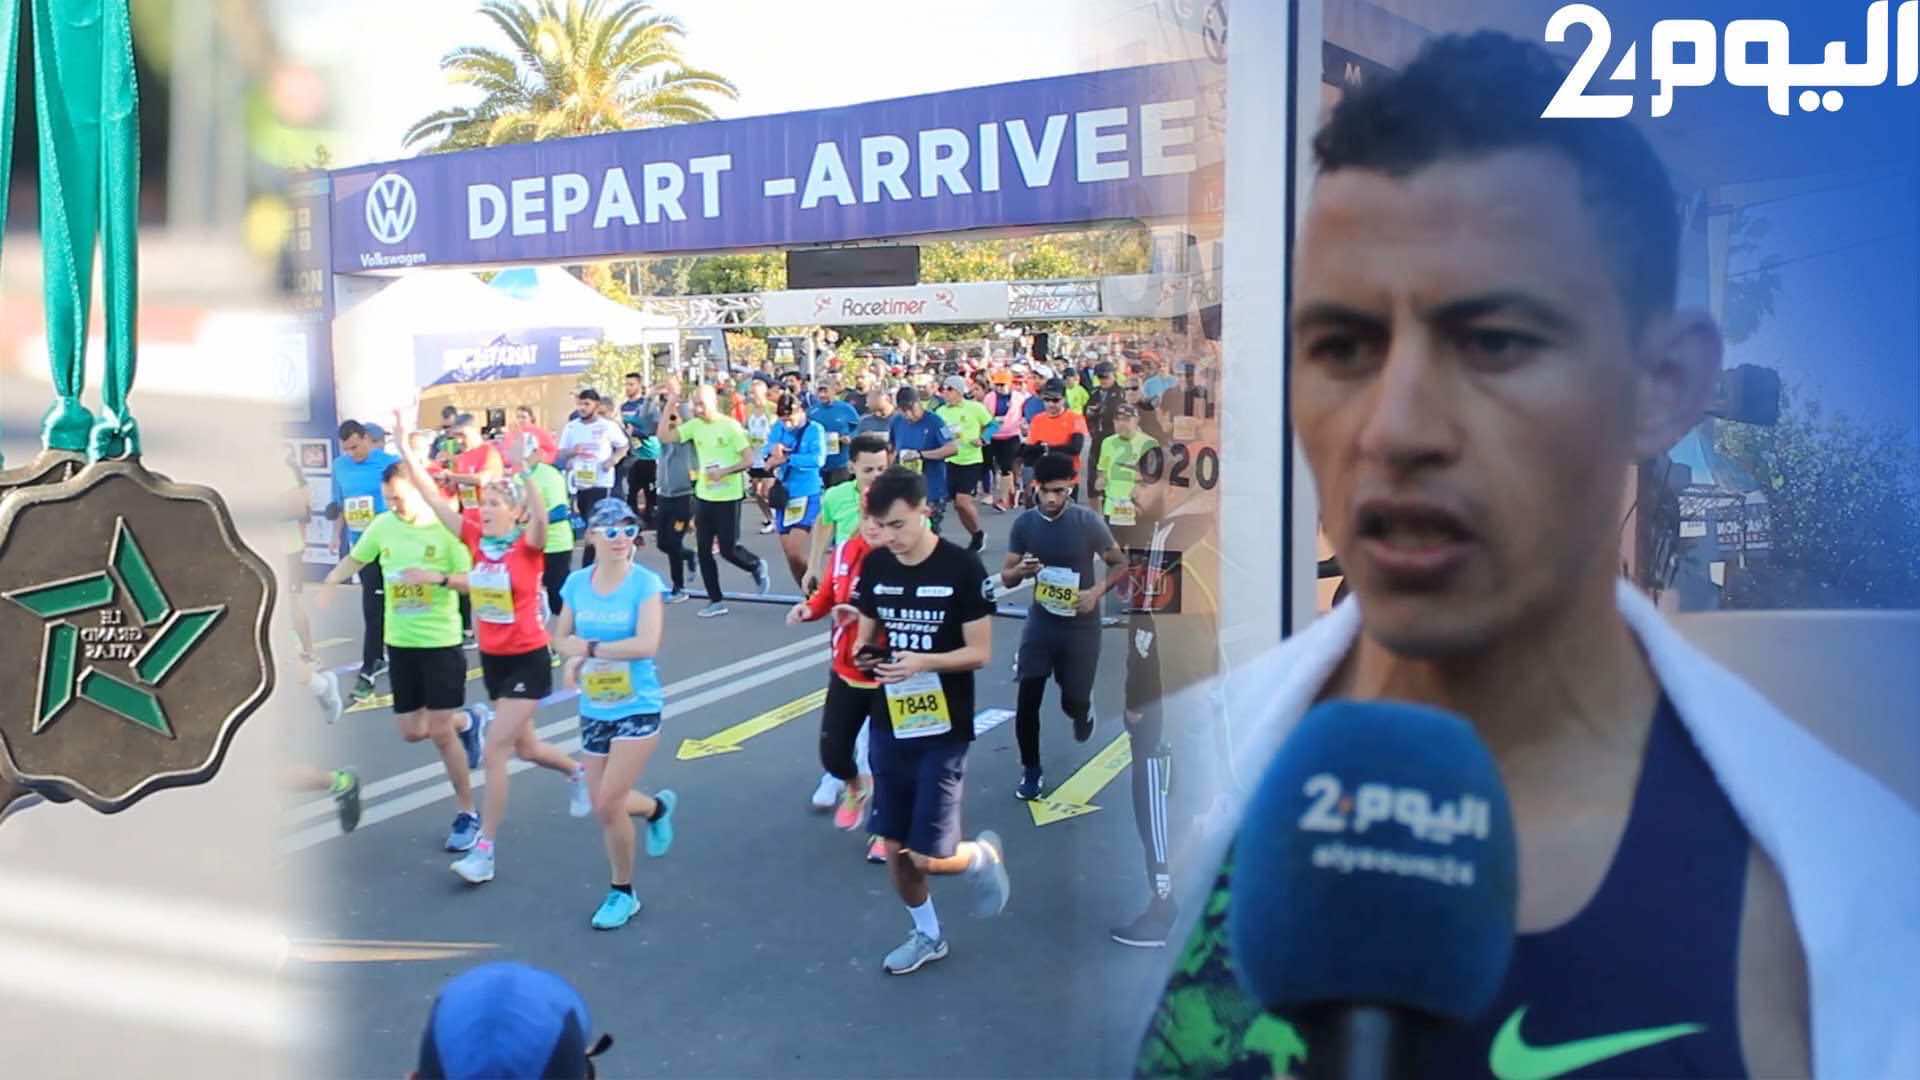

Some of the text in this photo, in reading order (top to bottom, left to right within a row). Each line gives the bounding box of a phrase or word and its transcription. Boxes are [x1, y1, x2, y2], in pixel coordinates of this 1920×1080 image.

[467, 154, 732, 240] DEPART
[359, 251, 427, 268] Volkswagen
[841, 297, 928, 317] Racetimer
[888, 630, 933, 651] 2020
[895, 694, 939, 715] 7848
